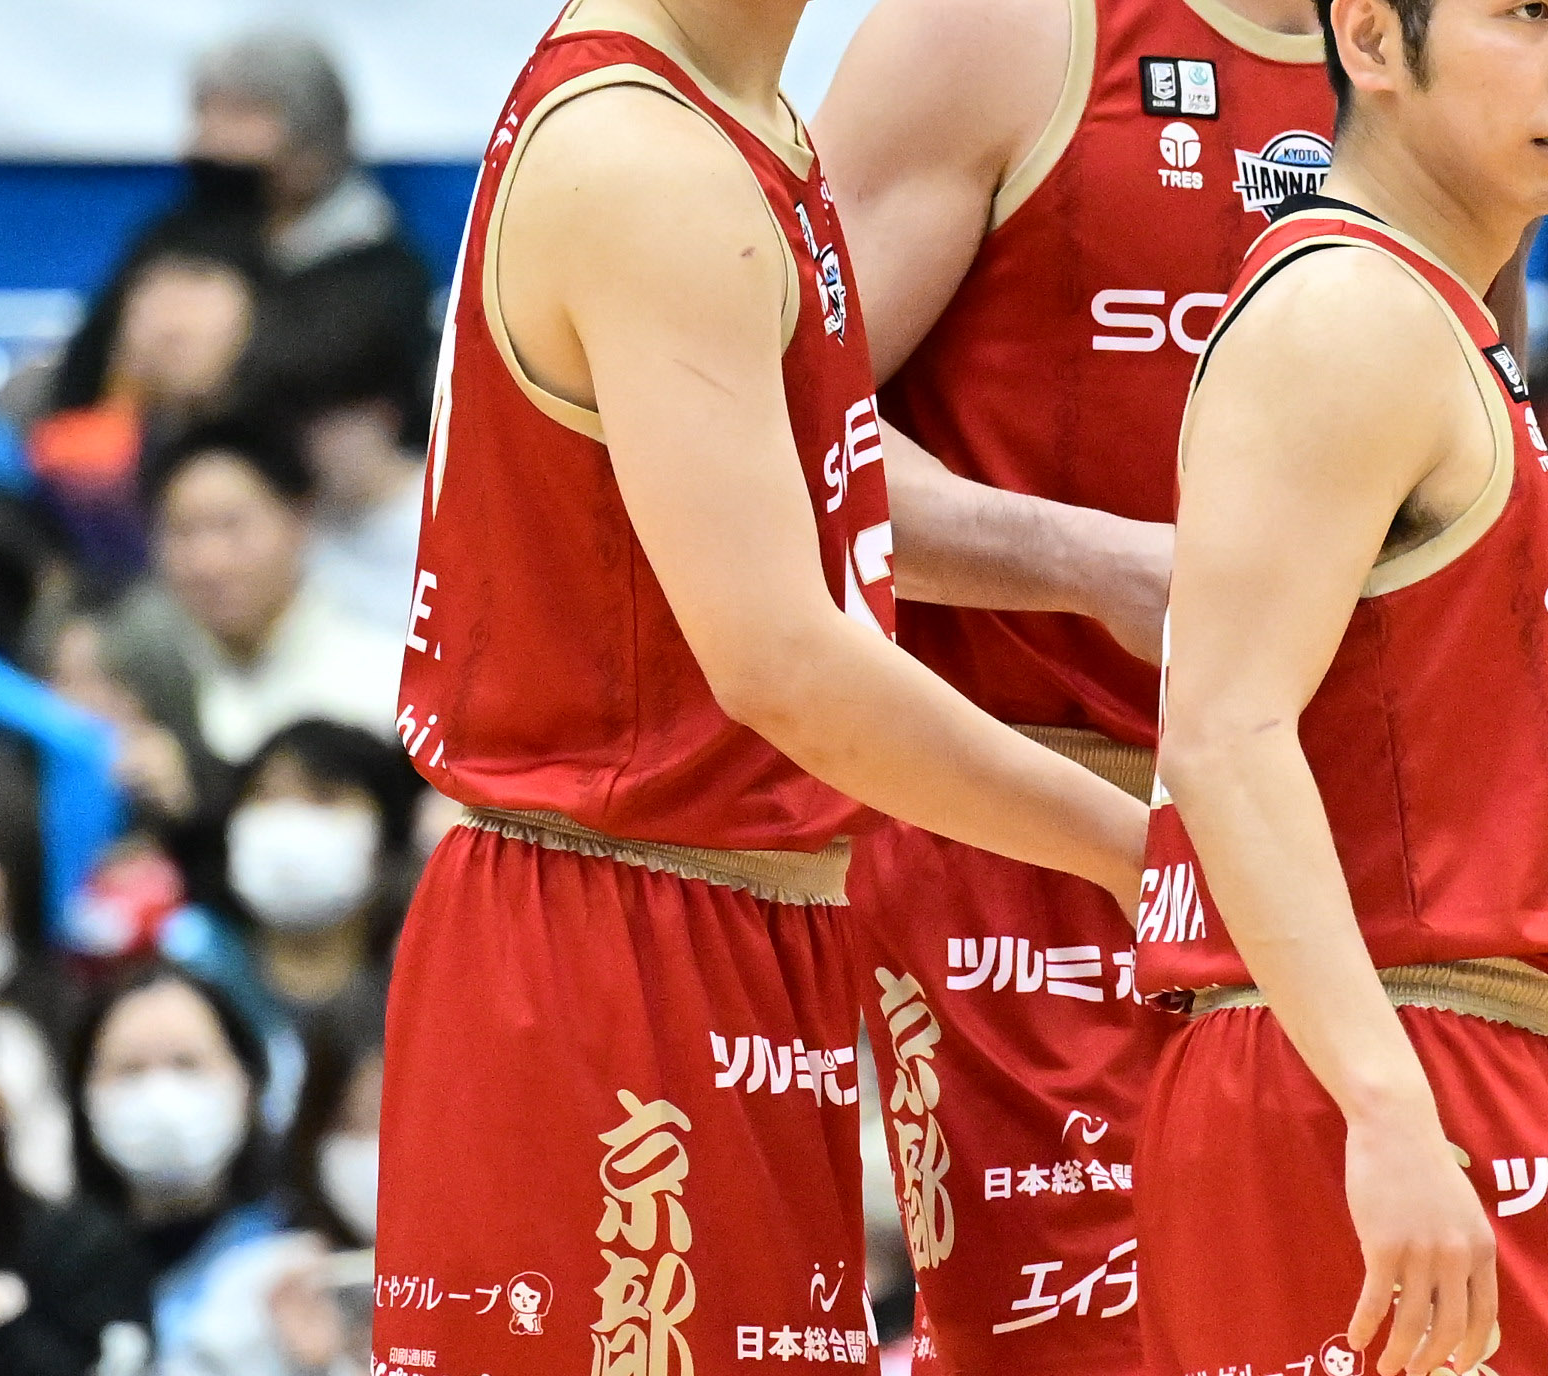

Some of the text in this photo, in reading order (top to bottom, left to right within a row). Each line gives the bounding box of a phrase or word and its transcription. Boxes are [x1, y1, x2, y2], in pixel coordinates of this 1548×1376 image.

[1284, 148, 1321, 162] KYOTO
[1158, 169, 1203, 190] TRES
[389, 1347, 437, 1368] 印刷通販
